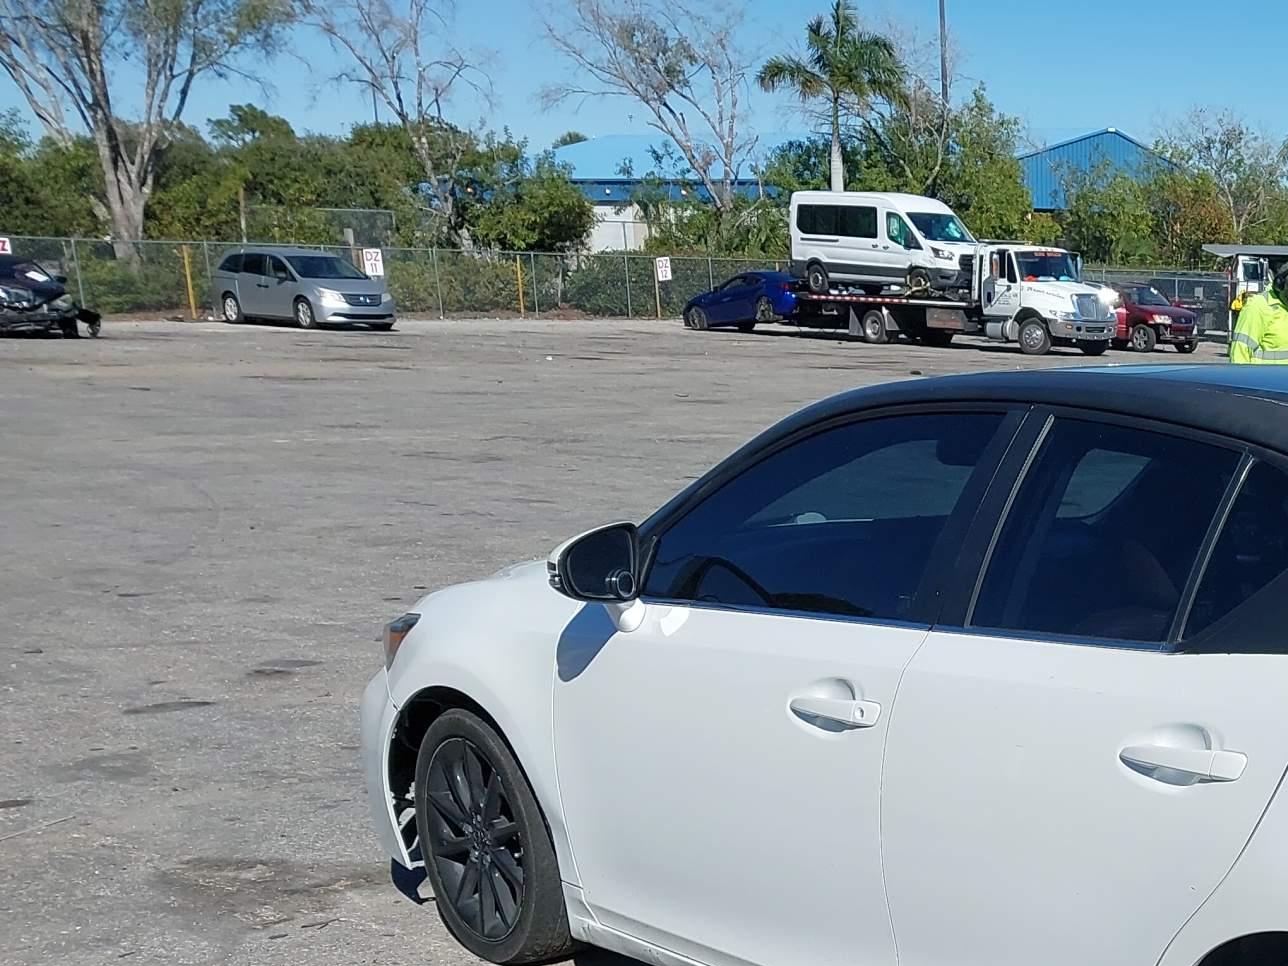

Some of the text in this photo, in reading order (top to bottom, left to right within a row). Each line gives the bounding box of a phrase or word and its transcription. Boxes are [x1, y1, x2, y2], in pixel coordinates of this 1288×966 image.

[364, 250, 380, 262] DZ
[370, 262, 378, 273] 11
[657, 258, 670, 269] DZ
[660, 269, 669, 279] 12
